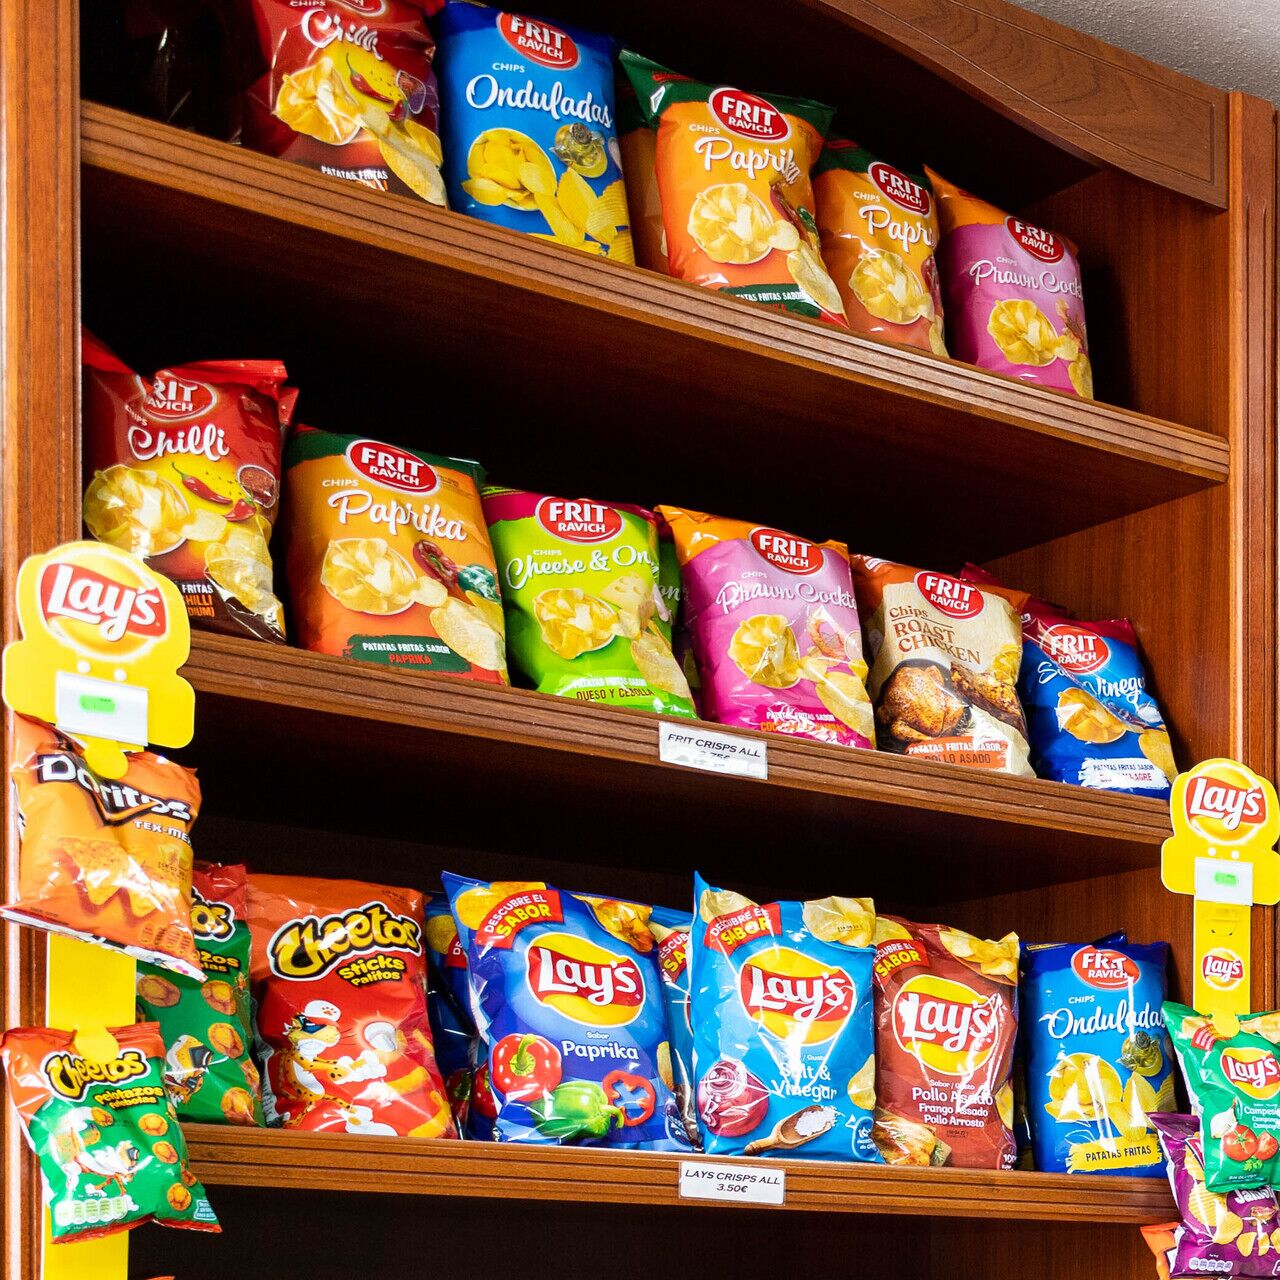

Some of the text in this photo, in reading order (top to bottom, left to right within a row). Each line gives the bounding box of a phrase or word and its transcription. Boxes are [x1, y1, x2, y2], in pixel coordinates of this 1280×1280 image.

[492, 62, 526, 74] CHIPS
[464, 73, 613, 127] Onduladas
[721, 94, 776, 126] FRIT
[727, 115, 773, 136] RAVICH
[694, 136, 802, 184] Paprika
[853, 190, 881, 203] CHIPS
[969, 259, 1037, 293] Prawn
[128, 425, 229, 461] Chilli
[359, 446, 421, 476] FRIT
[322, 477, 359, 489] CHIPS
[369, 466, 421, 488] RAVICH
[328, 490, 468, 541] Paprika
[548, 501, 606, 523] FRIT
[558, 519, 606, 535] RAVICH
[759, 532, 810, 560] FRIT
[506, 555, 586, 589] Cheese
[767, 552, 809, 568] RAVICH
[47, 562, 160, 642] Lay's
[924, 576, 977, 603] FRIT
[889, 605, 929, 621] Chips
[930, 594, 970, 612] RAVICH
[894, 620, 955, 644] ROAST
[898, 636, 980, 664] CHICKEN
[667, 733, 761, 758] FRIT CRISPS ALL
[1189, 780, 1263, 830] Lay's
[494, 903, 552, 939] SABOR
[268, 902, 422, 979] Cheetos
[337, 956, 405, 982] Sticks
[750, 966, 848, 1021] Lay's
[561, 1039, 640, 1062] Paprika
[44, 1050, 150, 1100] Cheetos
[911, 1087, 947, 1103] Pollo
[1121, 1145, 1152, 1159] FRITAS
[684, 1170, 781, 1187] LAYS CRISPS ALL
[716, 1183, 748, 1194] 3.50€
